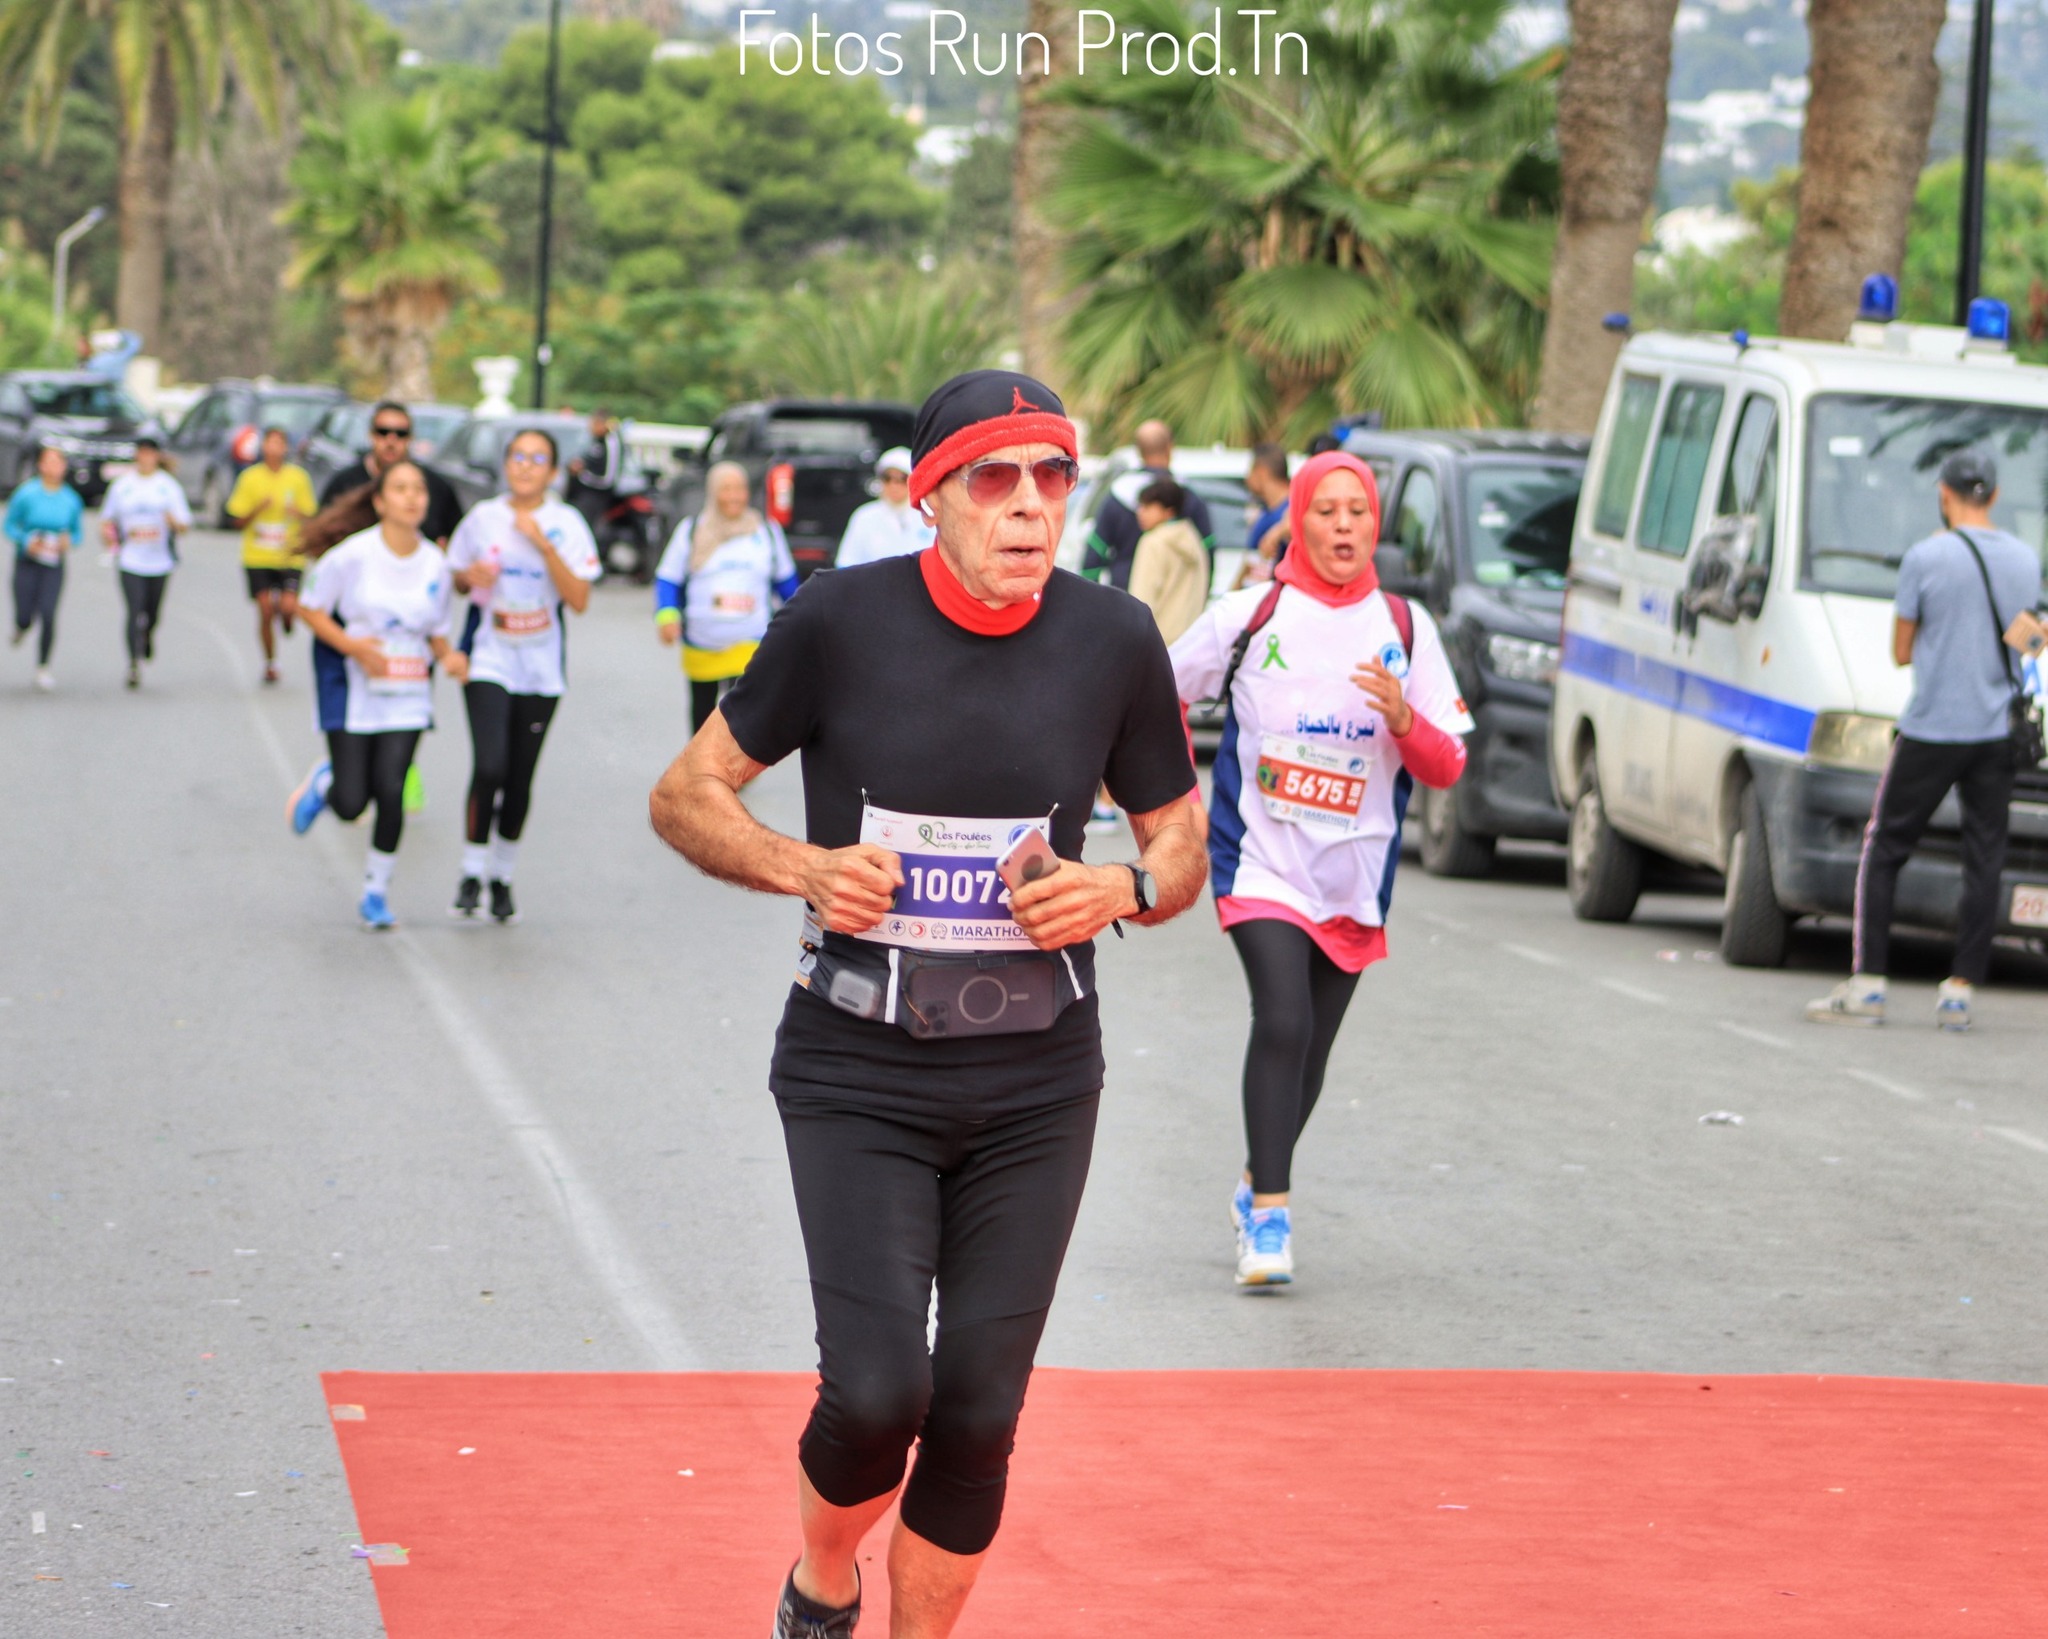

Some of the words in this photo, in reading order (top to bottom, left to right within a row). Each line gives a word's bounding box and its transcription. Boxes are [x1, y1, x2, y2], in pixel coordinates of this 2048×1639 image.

[1296, 713, 1341, 740] بالحياة
[1346, 719, 1376, 742] تبرع
[1284, 769, 1346, 805] 5675
[1303, 810, 1351, 826] MARATHON
[936, 831, 953, 840] Les
[955, 831, 992, 842] Foulées
[952, 925, 1028, 937] MARATHO
